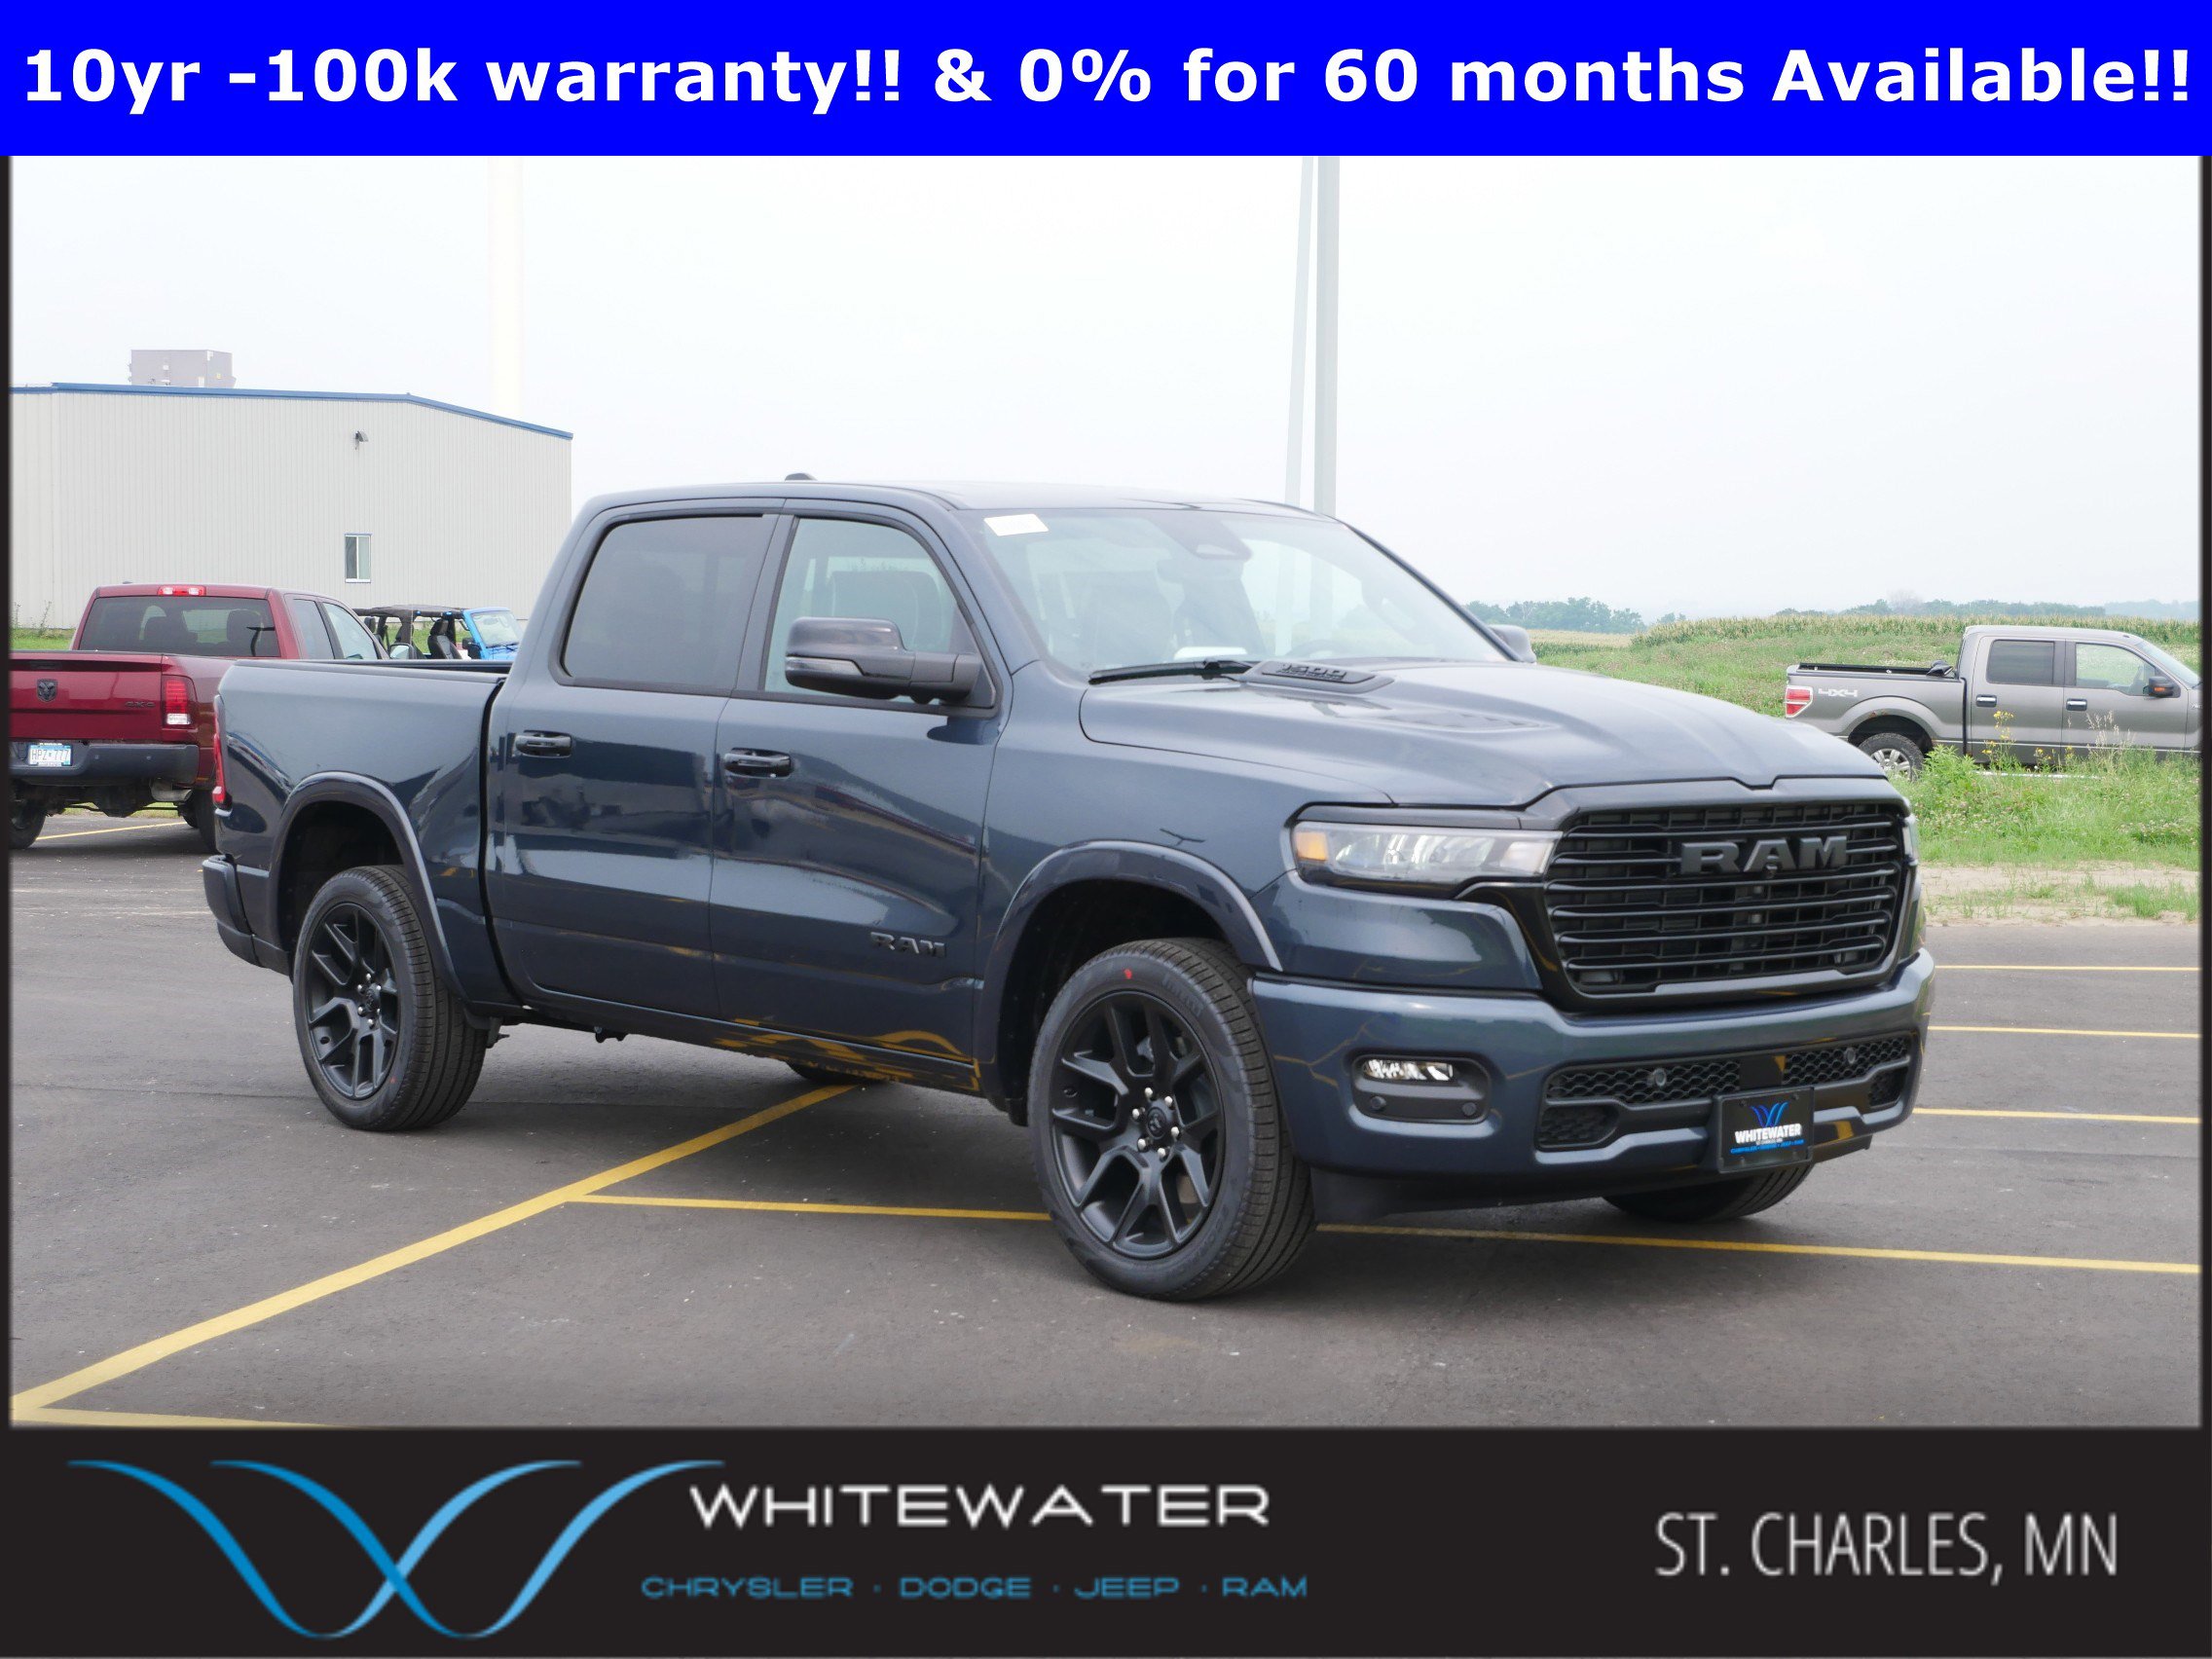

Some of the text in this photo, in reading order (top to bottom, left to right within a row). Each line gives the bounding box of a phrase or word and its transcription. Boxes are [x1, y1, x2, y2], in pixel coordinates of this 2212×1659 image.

[1680, 835, 1848, 874] RAM
[869, 931, 947, 959] RAM
[1734, 1123, 1803, 1144] WHITEWATER
